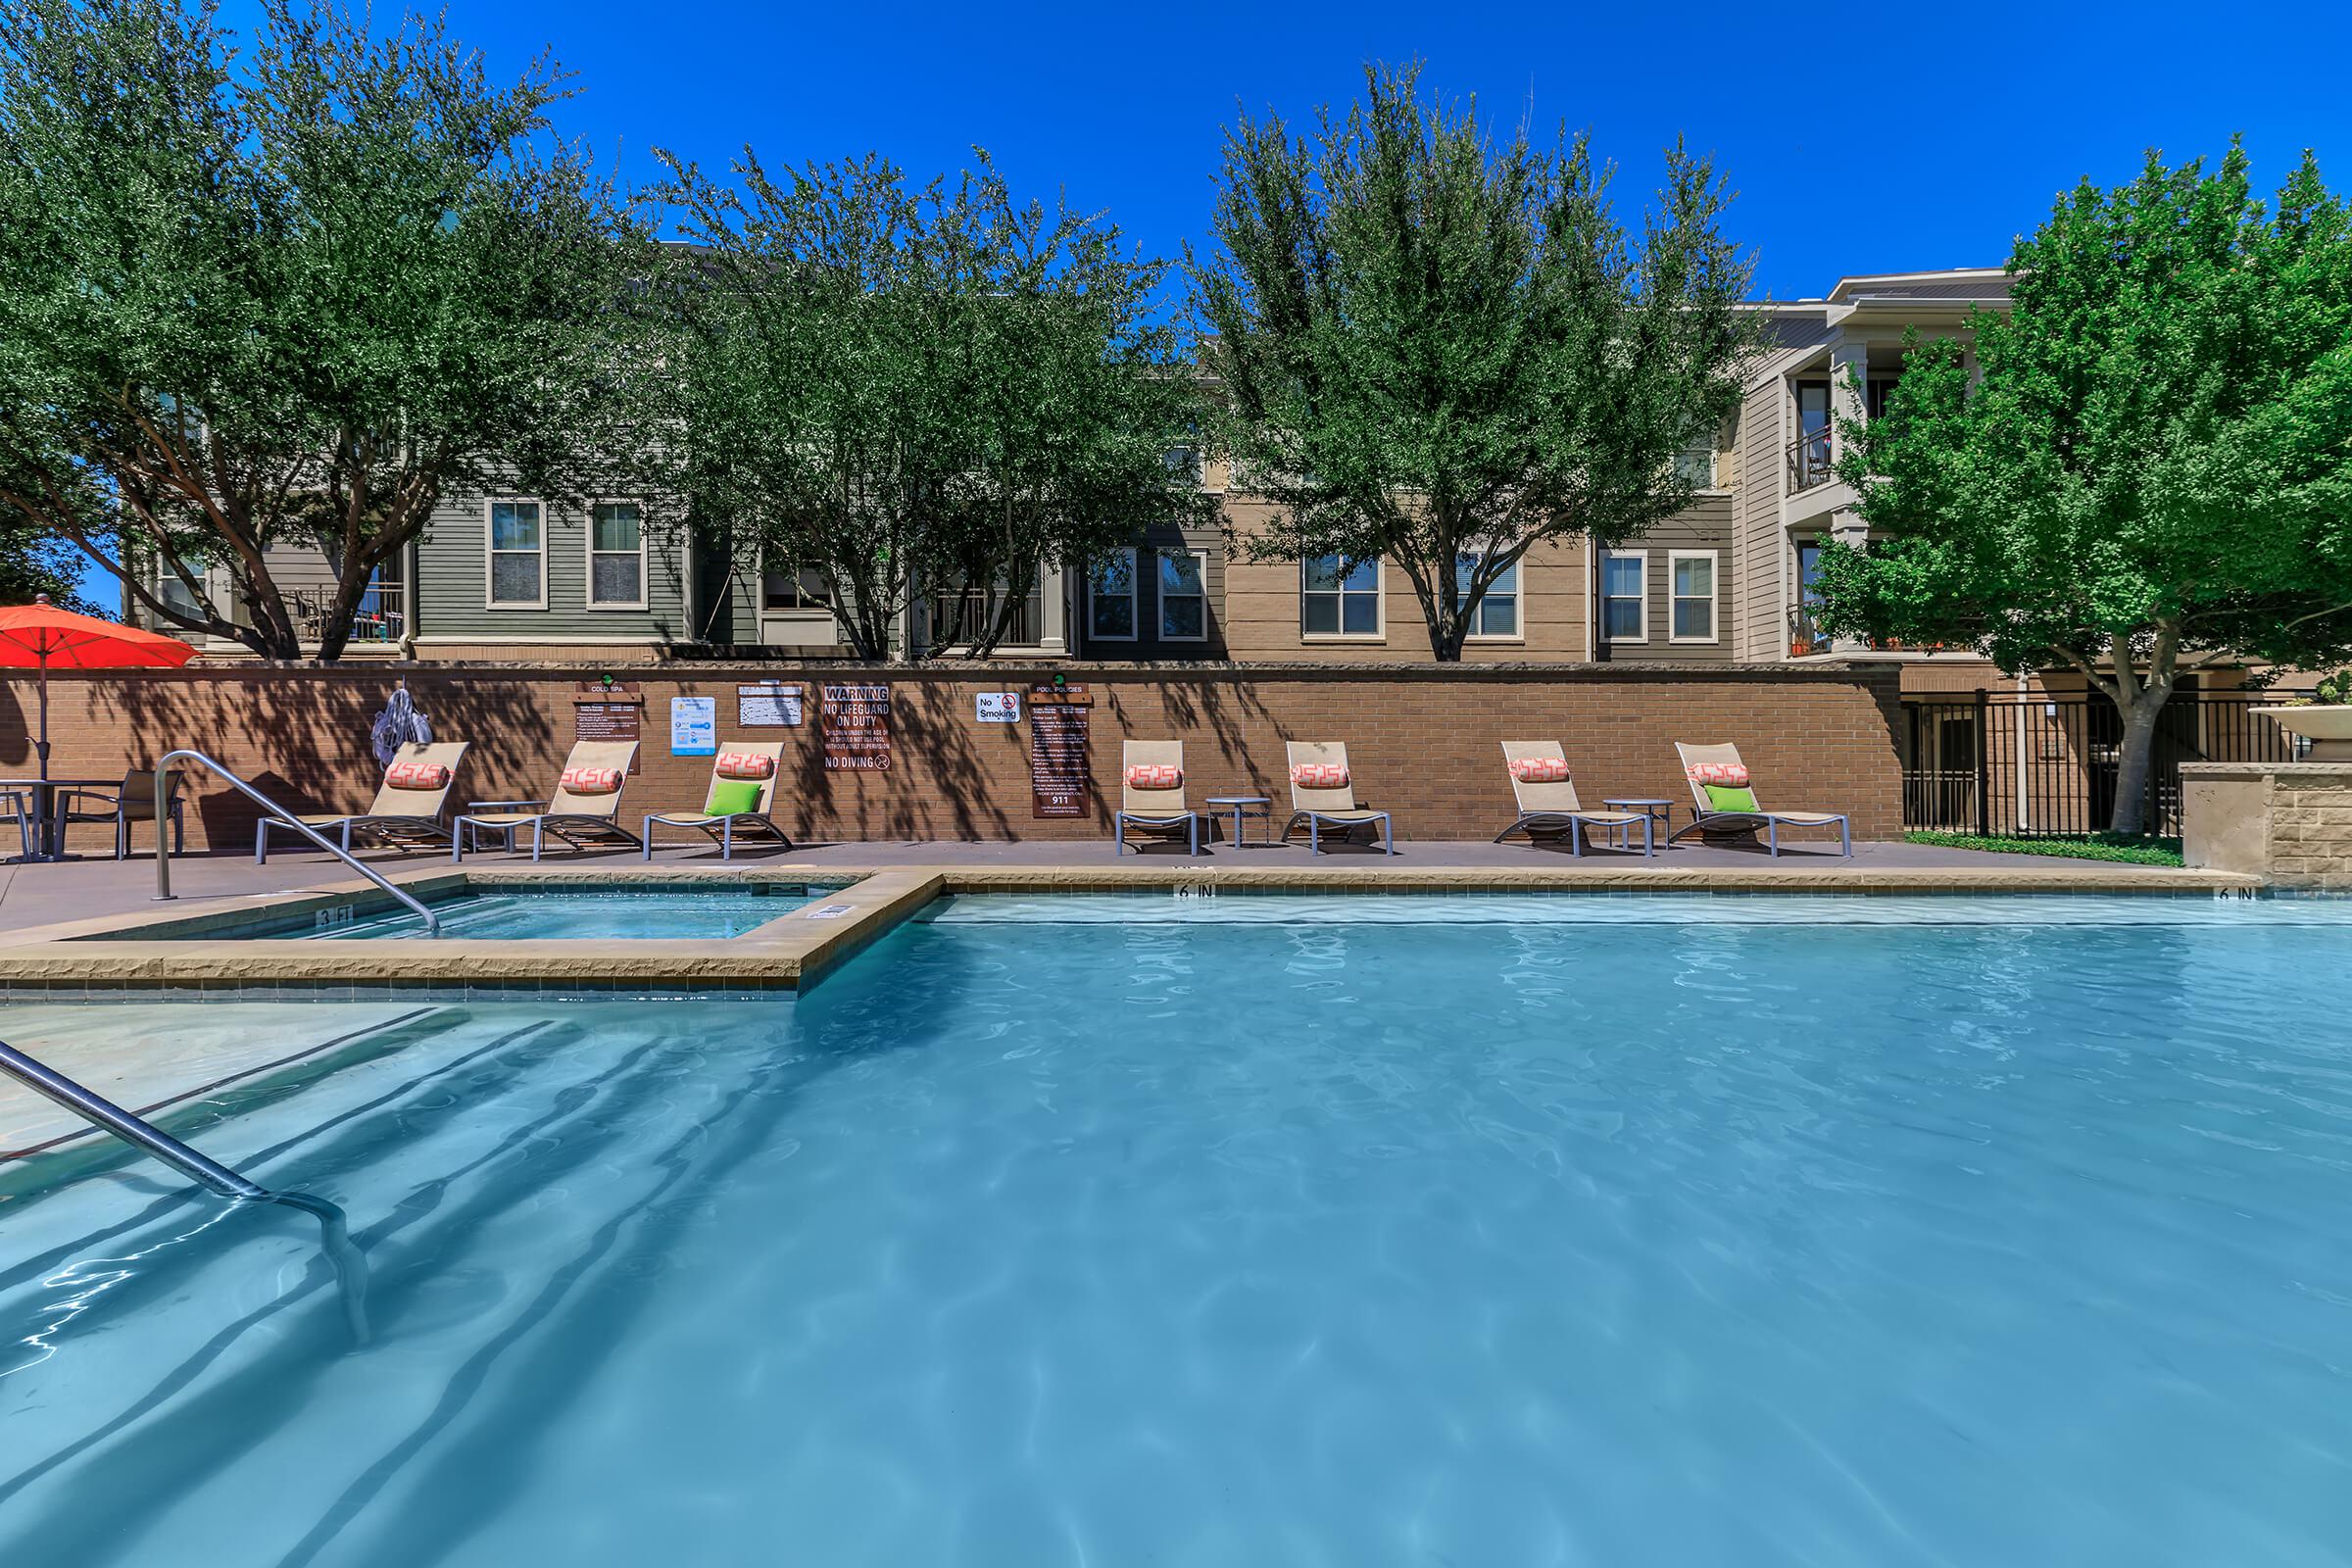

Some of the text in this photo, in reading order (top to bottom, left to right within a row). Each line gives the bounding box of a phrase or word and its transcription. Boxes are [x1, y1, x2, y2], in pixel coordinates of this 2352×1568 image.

[826, 688, 888, 700] WARNING
[980, 698, 992, 707] No
[824, 704, 889, 714] NO LIFEGUARD
[980, 709, 1016, 719] Smoking
[837, 715, 877, 726] ON DUTY
[825, 757, 873, 768] NO DIVING
[1053, 796, 1068, 805] 911
[1179, 884, 1212, 898] 6 IN
[2219, 887, 2252, 900] 6 IN
[320, 906, 351, 926] 3 FT
